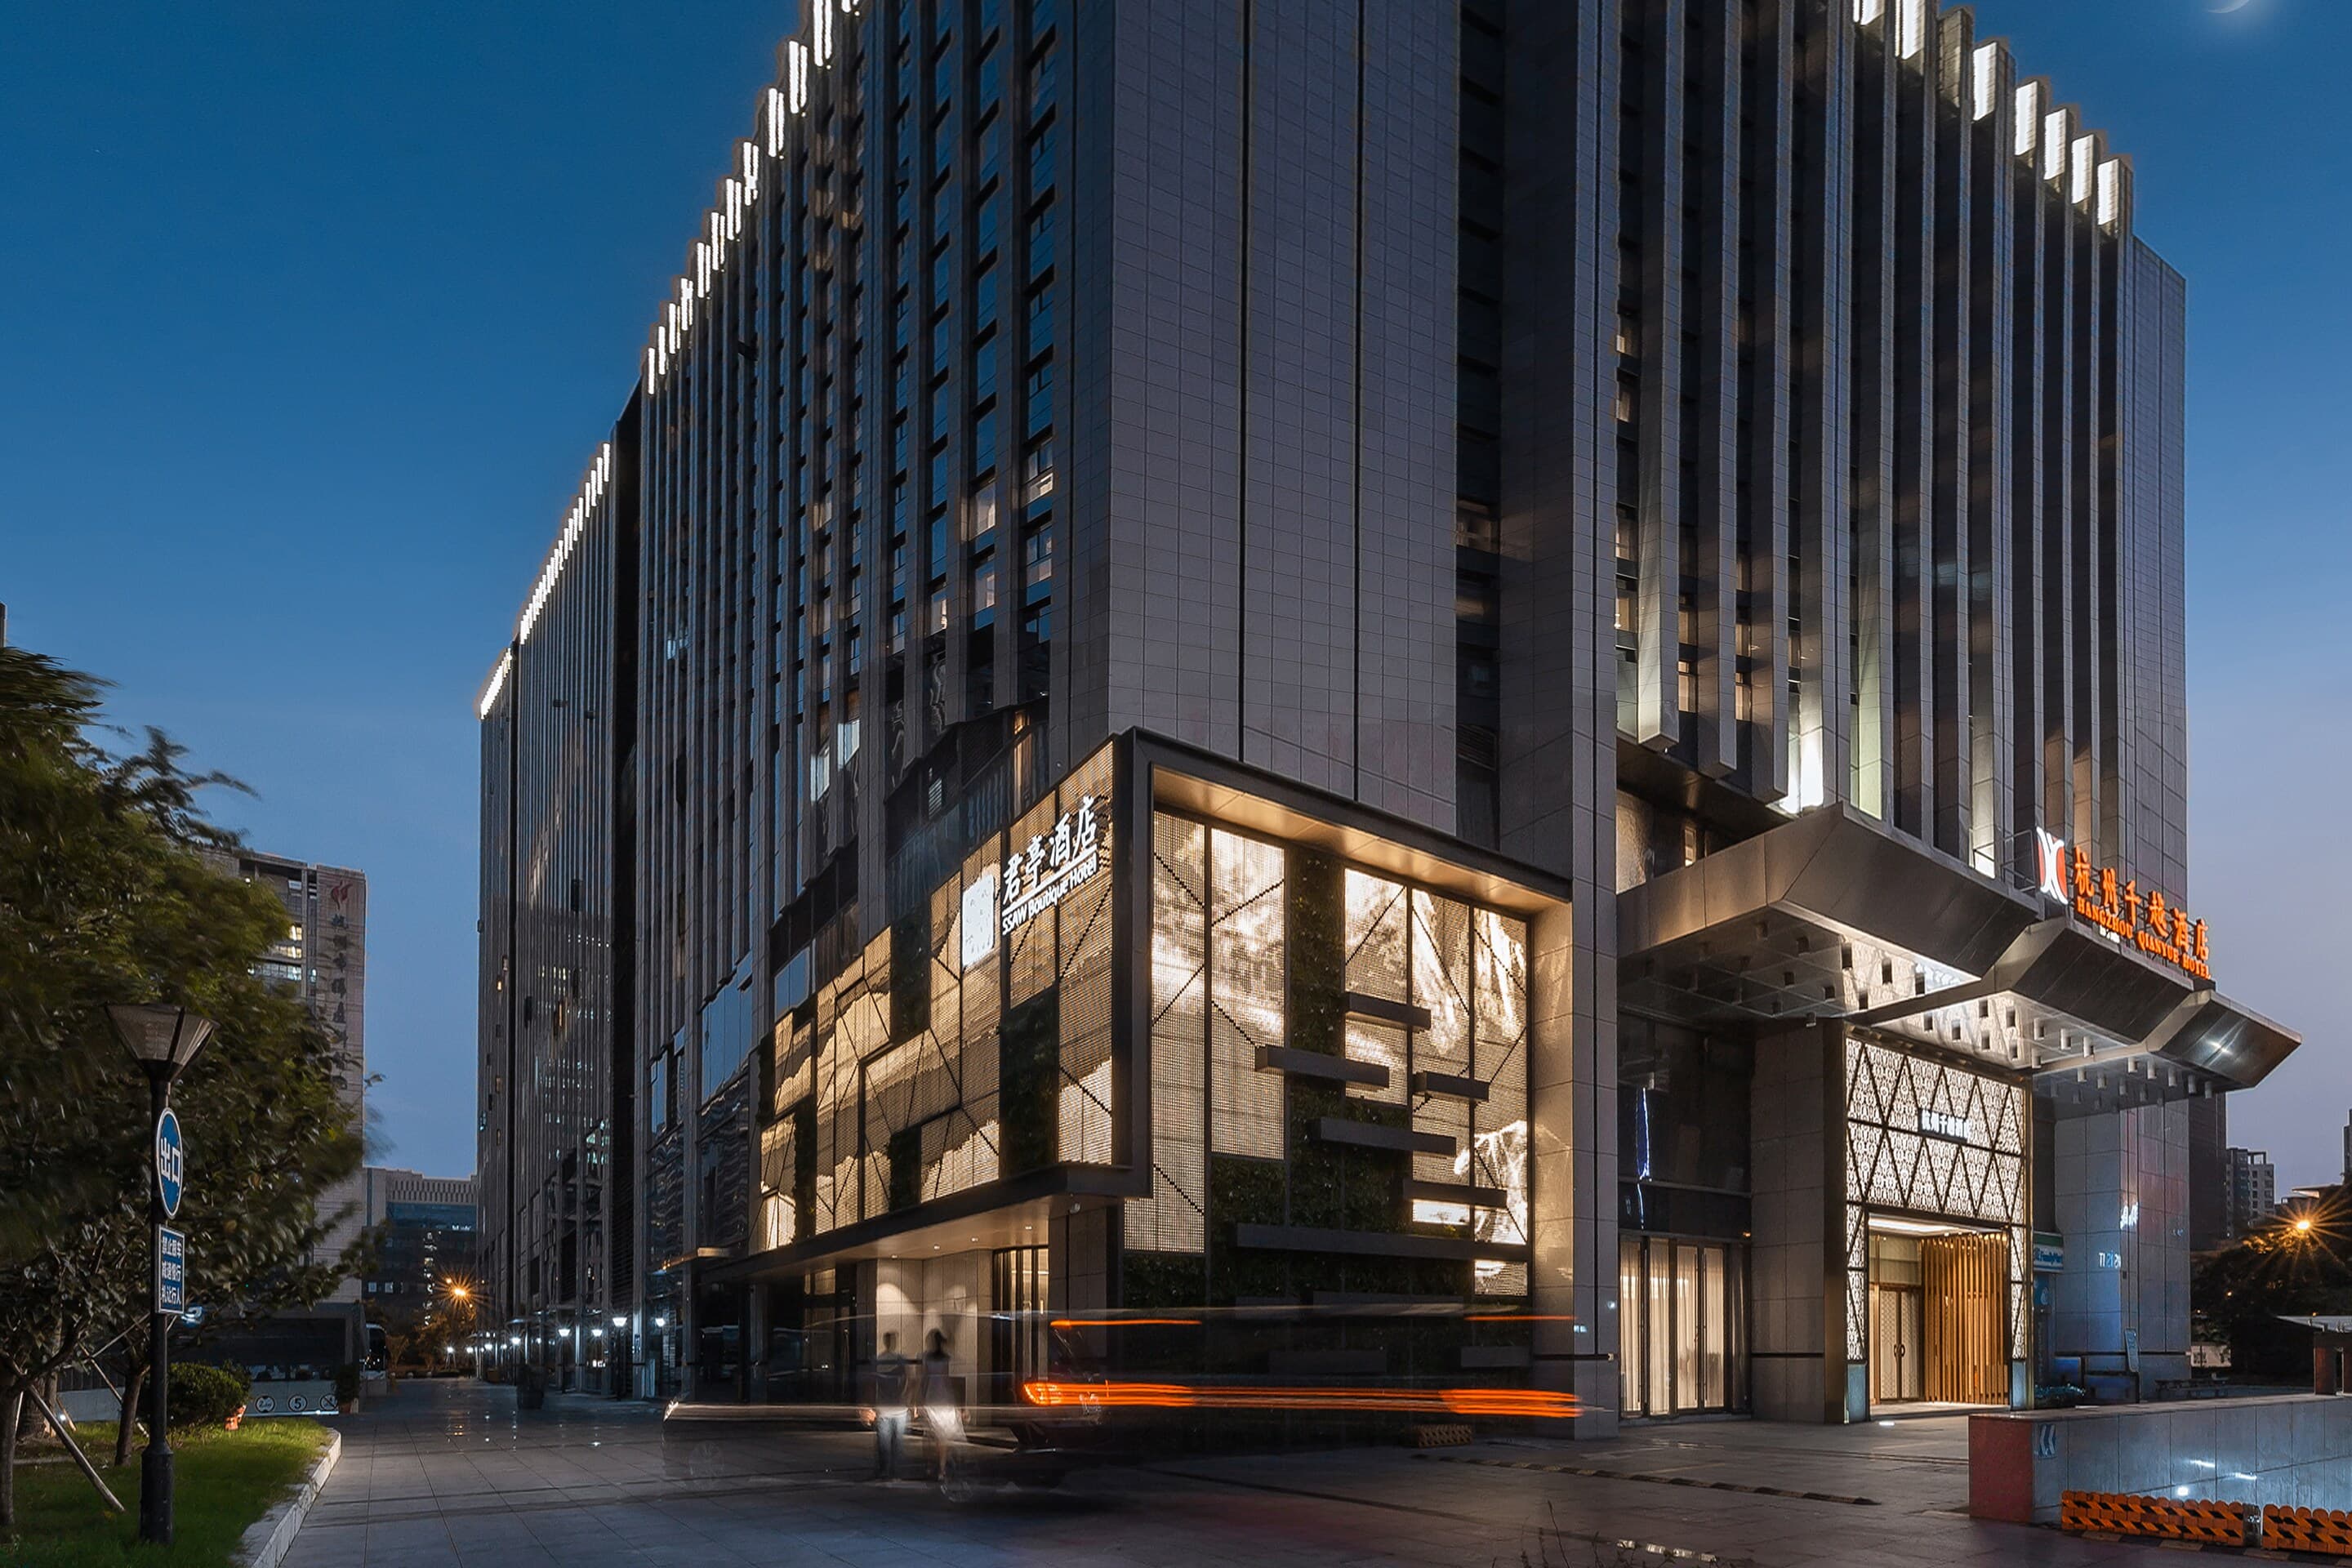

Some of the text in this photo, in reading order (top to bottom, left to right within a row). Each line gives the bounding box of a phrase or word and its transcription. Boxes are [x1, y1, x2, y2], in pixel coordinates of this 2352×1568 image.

[1002, 795, 1097, 905] 君亭酒店
[1002, 903, 1027, 935] SSAW
[1028, 880, 1069, 919] Boutique
[1070, 853, 1097, 890] Hotel
[2074, 846, 2210, 960] 杭州千越酒店
[2077, 896, 2211, 979] HANGZHOU QIANYUE HOTEL
[160, 1137, 180, 1187] 出口
[294, 1397, 301, 1409] 5
